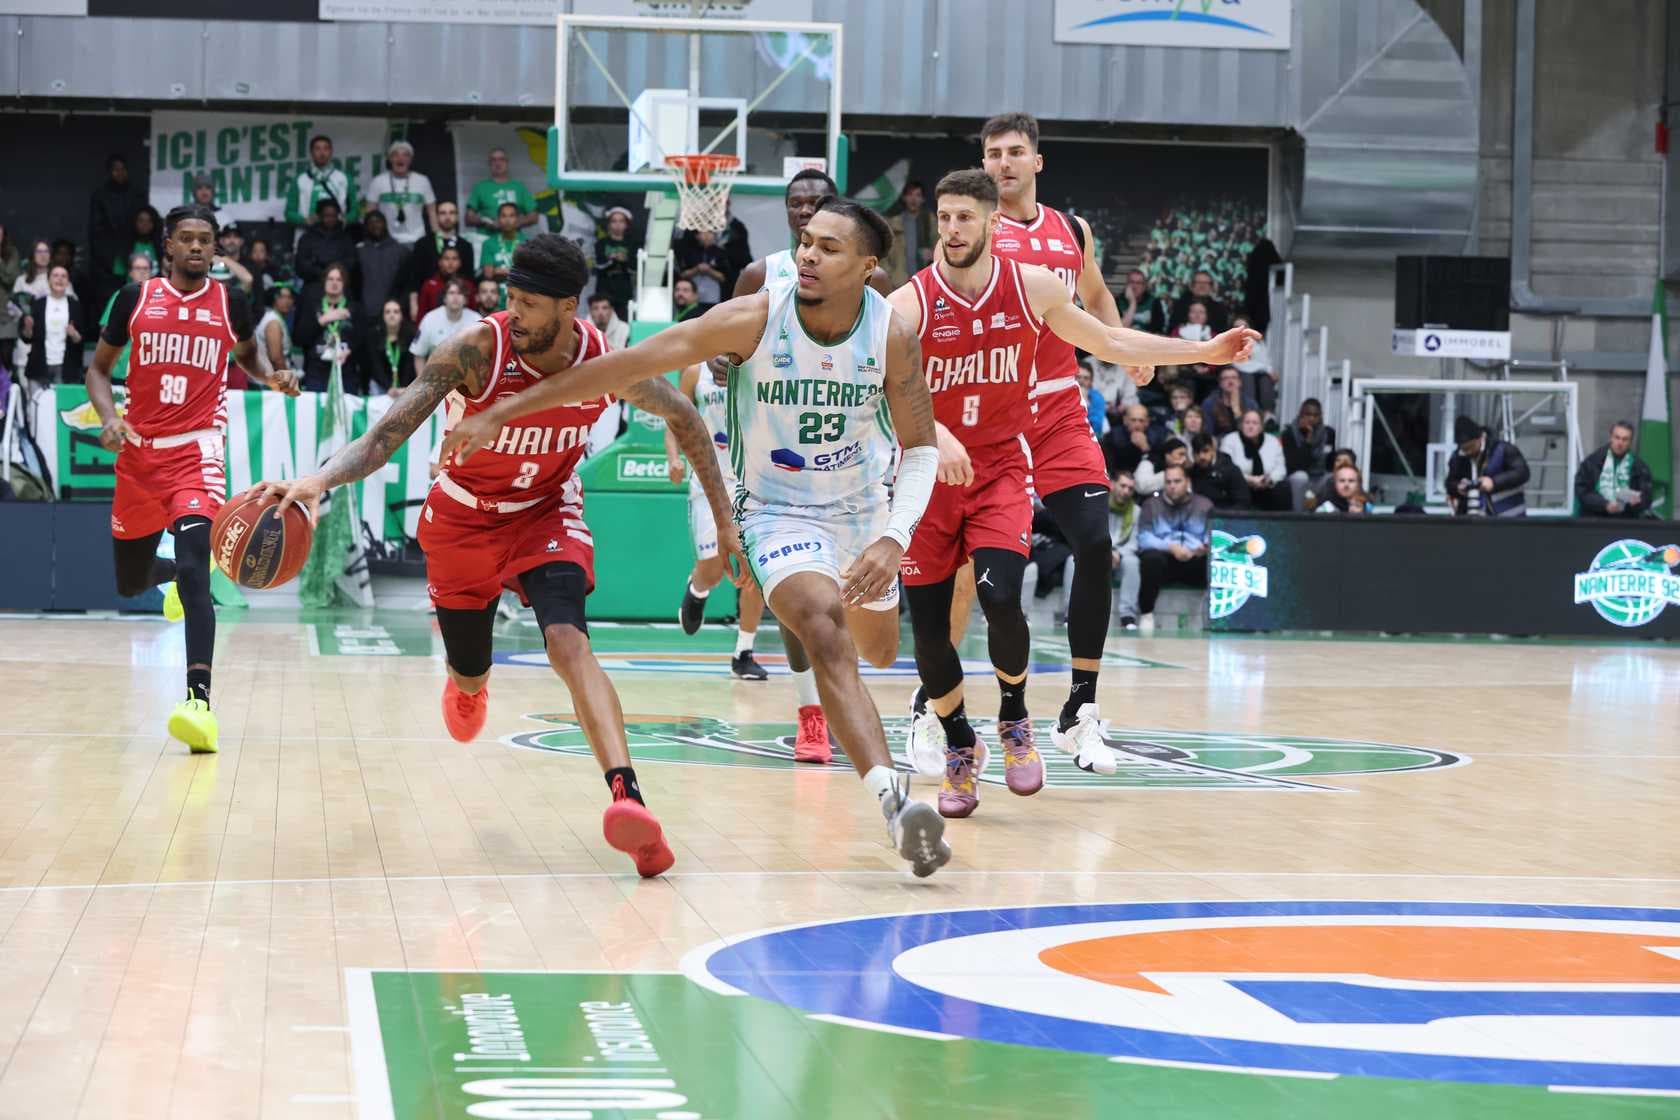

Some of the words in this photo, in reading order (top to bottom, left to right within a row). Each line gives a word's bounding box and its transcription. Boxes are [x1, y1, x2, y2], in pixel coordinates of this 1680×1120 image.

[156, 129, 207, 171] ICI
[216, 121, 313, 167] C'EST
[138, 331, 221, 375] CHALON
[925, 343, 1021, 394] CHALON
[159, 373, 188, 405] 39
[757, 379, 867, 407] NANTERRE
[961, 394, 981, 427] 5
[798, 411, 847, 445] 23
[814, 440, 860, 466] GTM
[511, 461, 540, 489] 2
[1579, 574, 1656, 597] NANTERRE
[1662, 579, 1680, 600] 92
